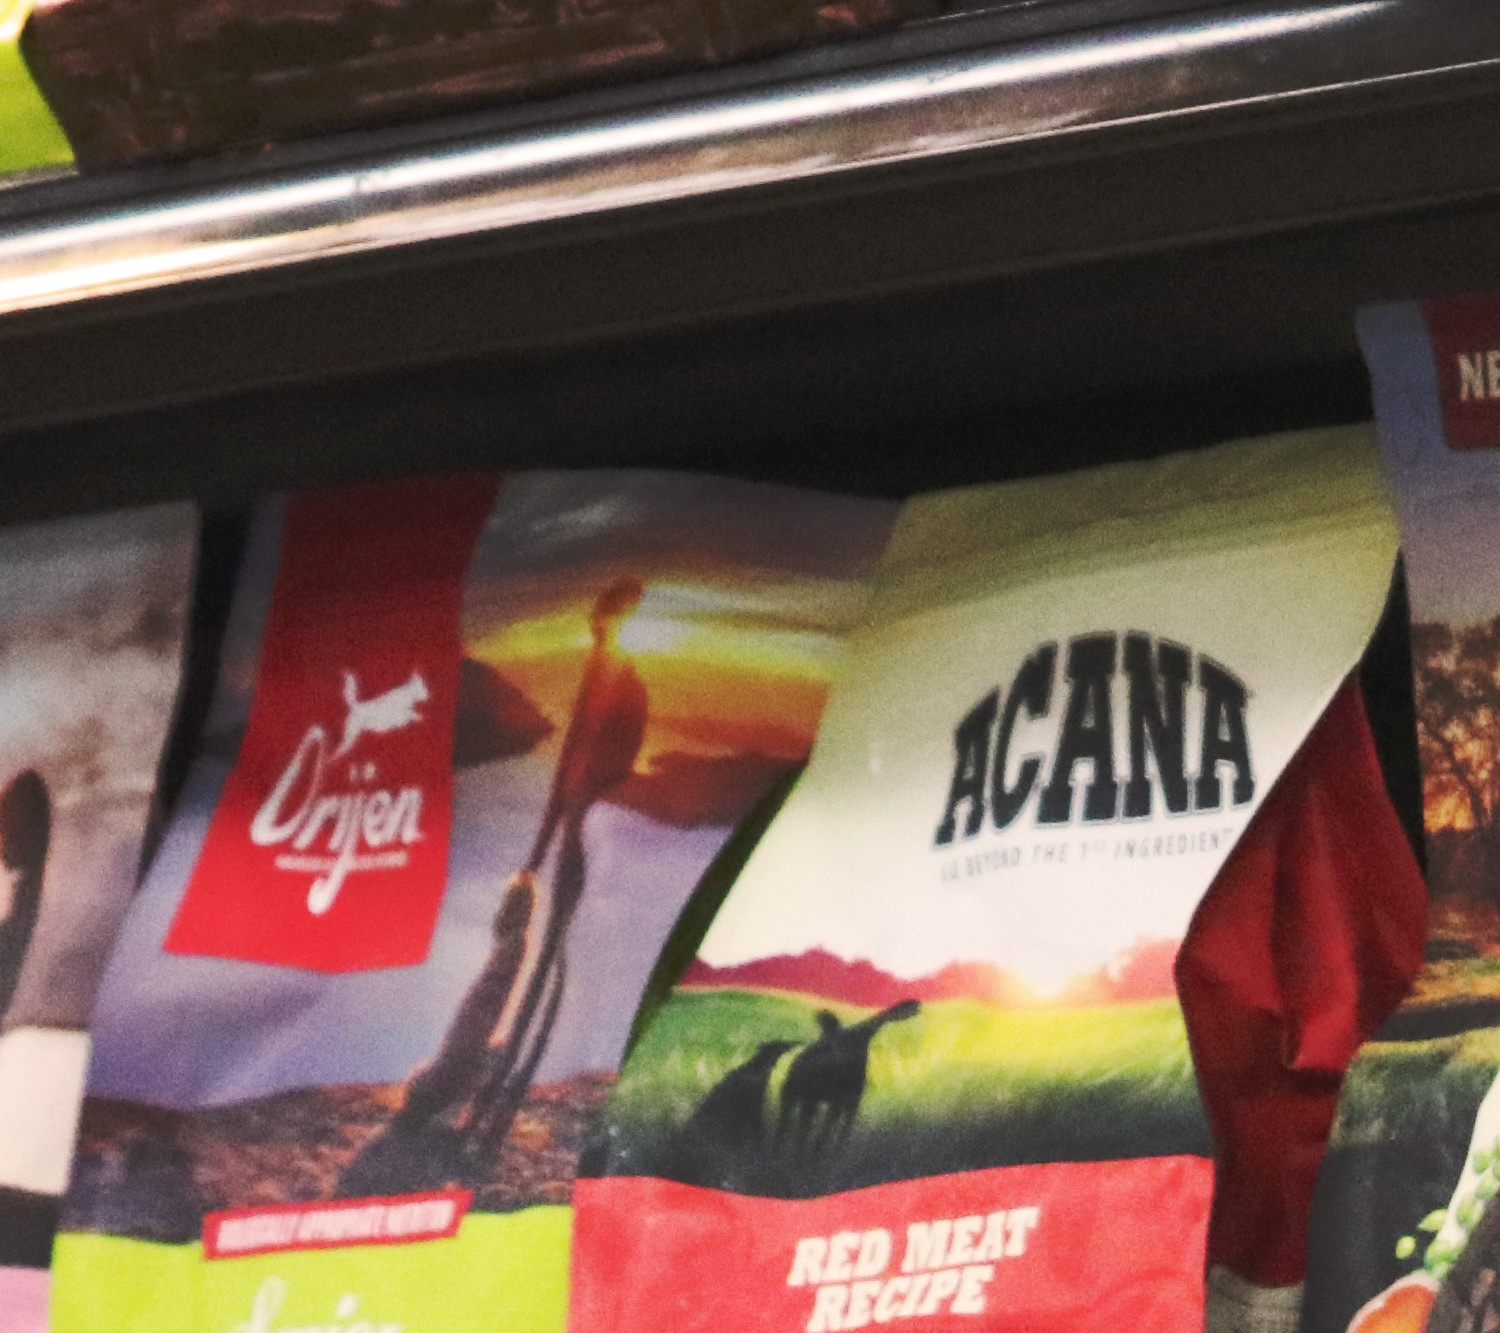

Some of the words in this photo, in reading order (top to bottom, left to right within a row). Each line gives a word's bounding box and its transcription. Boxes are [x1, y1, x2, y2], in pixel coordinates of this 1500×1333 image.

[932, 629, 1256, 849] ACANA
[787, 1228, 893, 1286] RED
[901, 1206, 1040, 1273] MEAT
[806, 1265, 994, 1333] RECIPE
